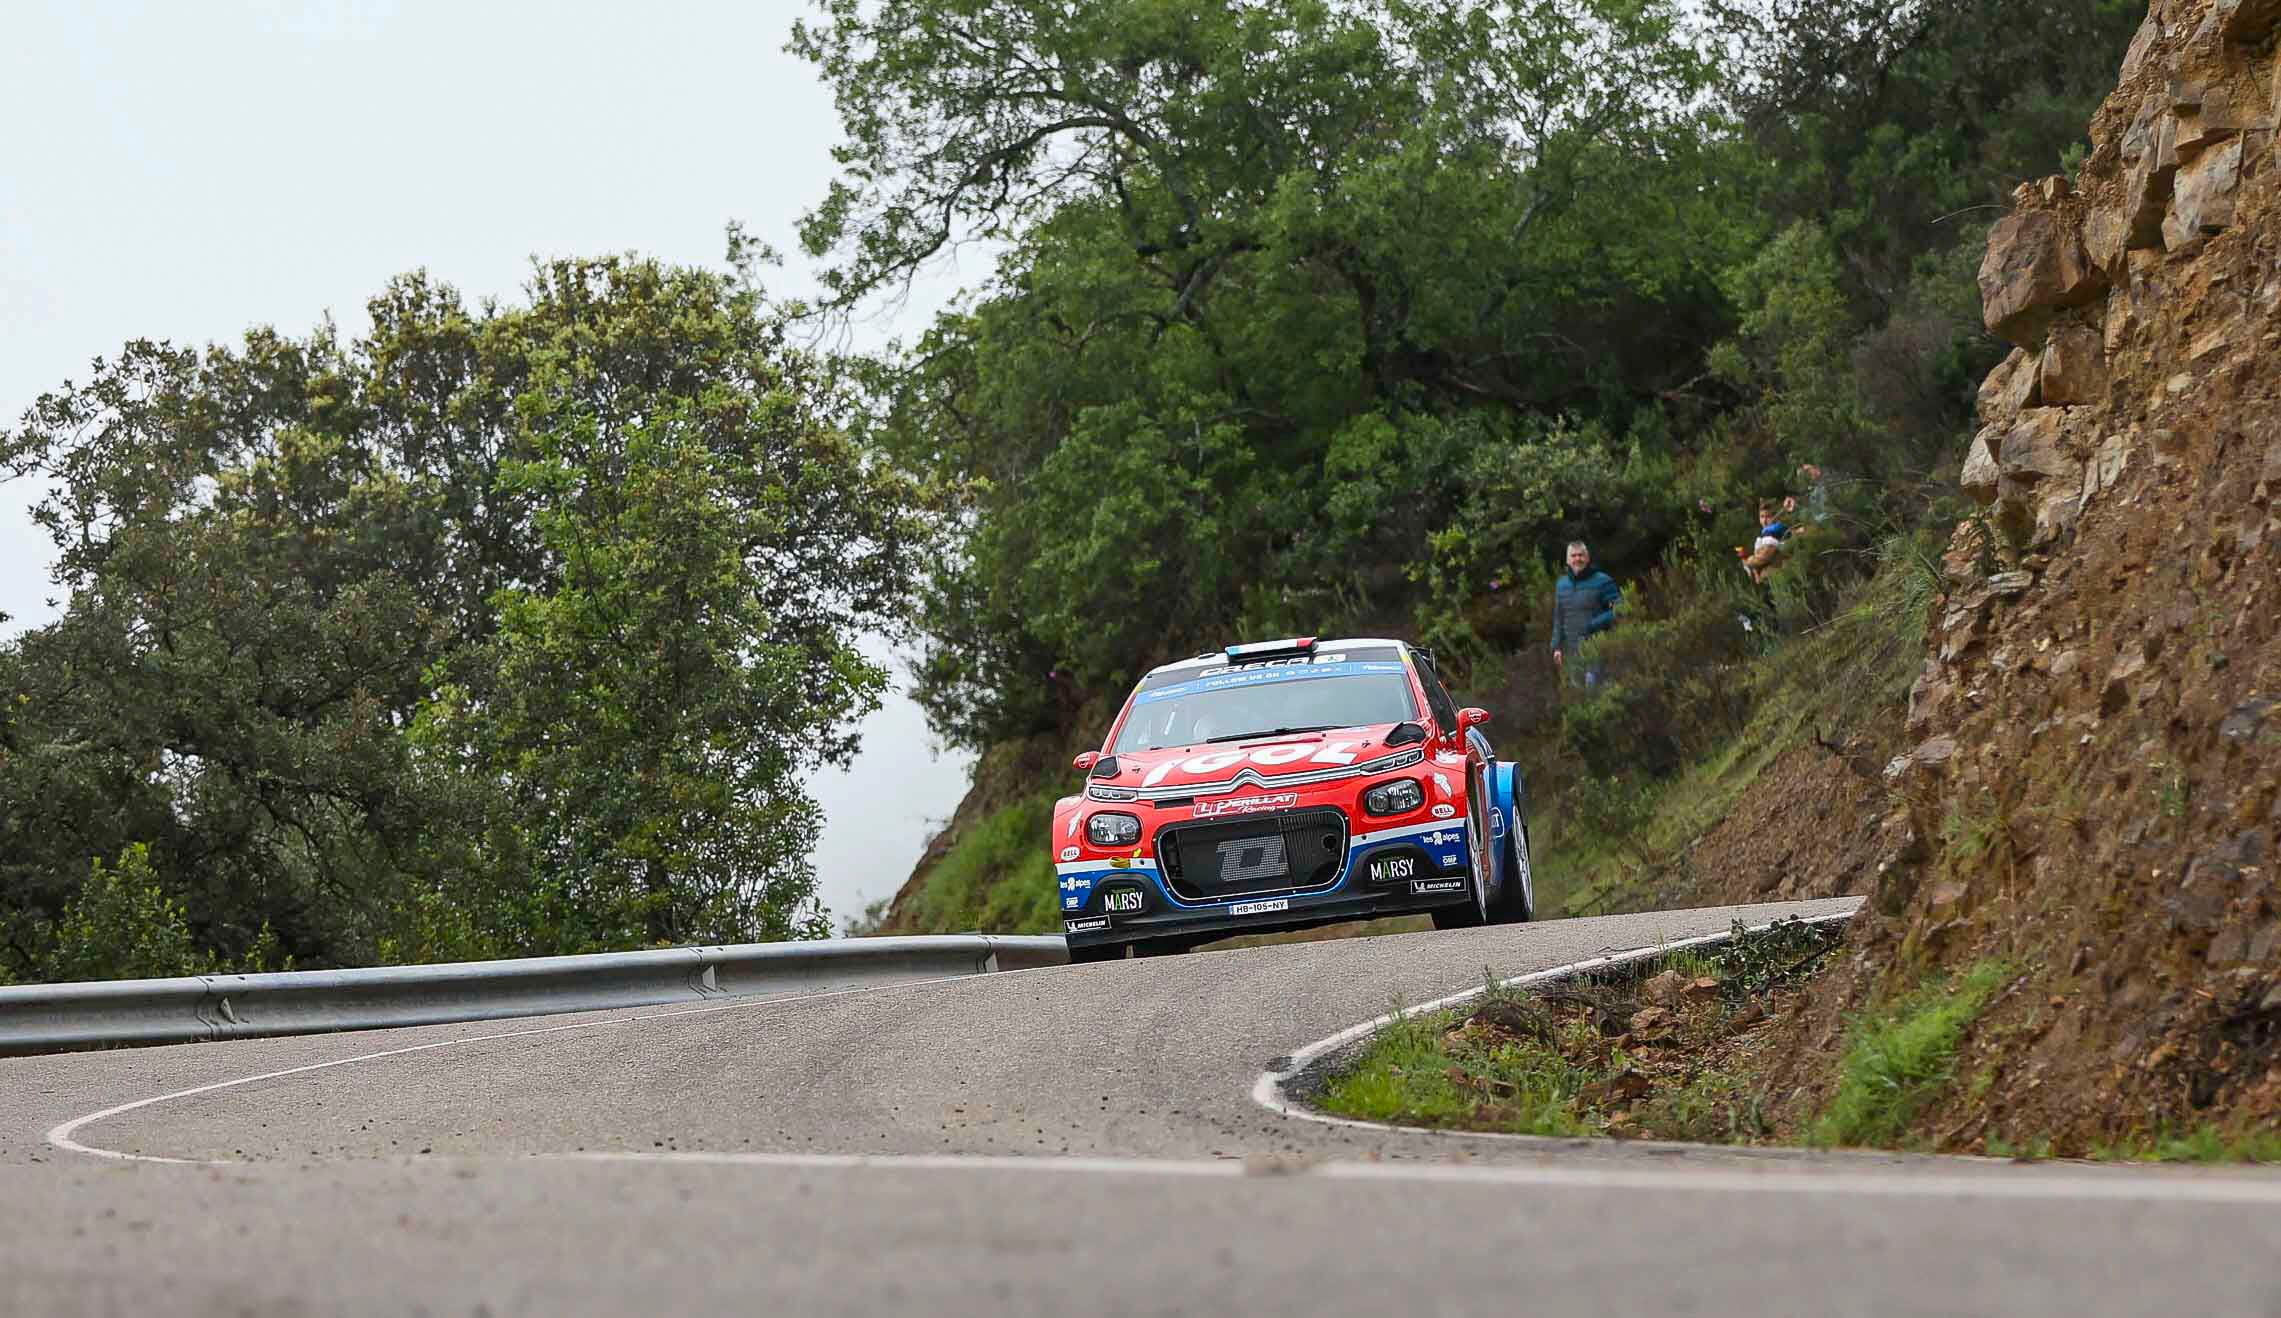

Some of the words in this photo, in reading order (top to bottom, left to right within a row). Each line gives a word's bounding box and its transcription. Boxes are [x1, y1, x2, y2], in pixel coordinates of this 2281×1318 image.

[1434, 806, 1453, 814] BELL
[1370, 858, 1414, 880] MARSY
[1104, 891, 1143, 911] MARSY
[1236, 901, 1285, 914] HB-105-NY
[1077, 920, 1106, 929] MICHELIN
